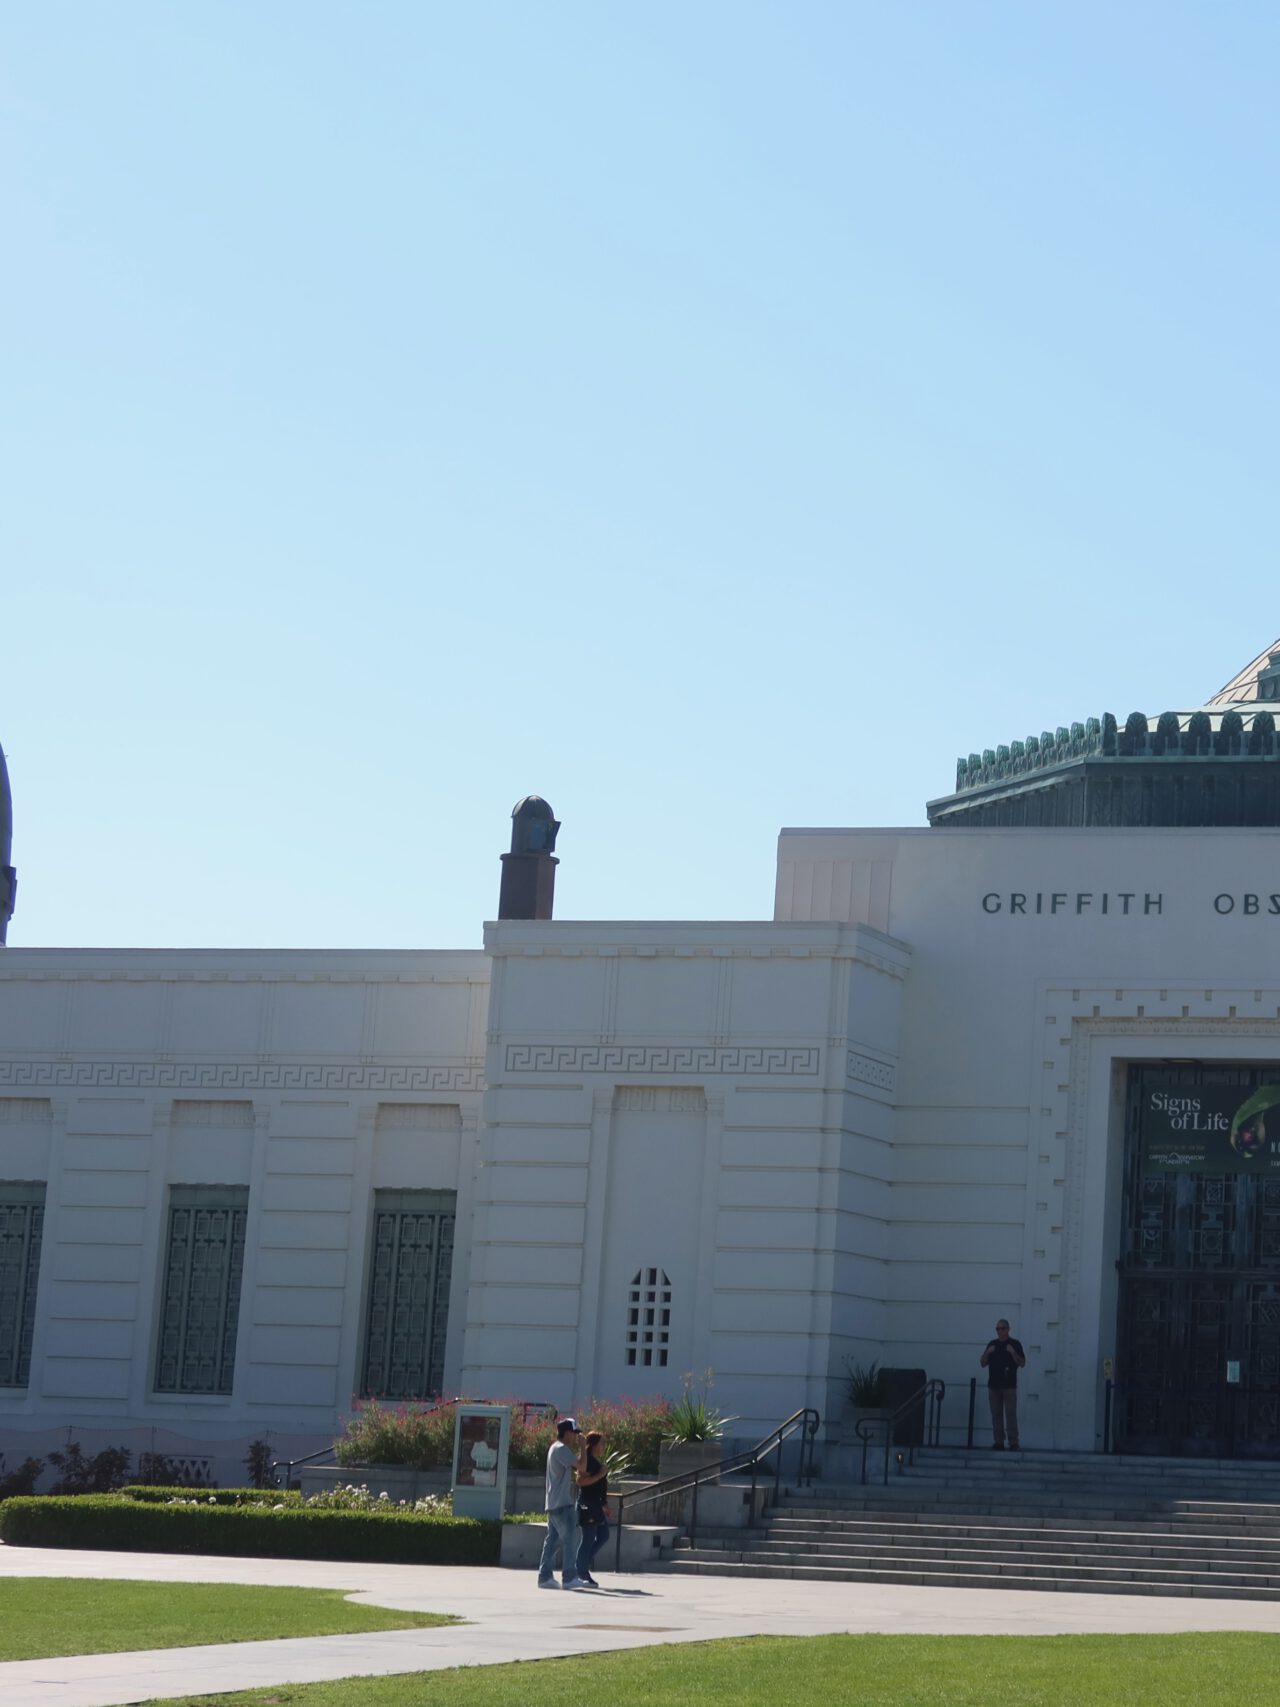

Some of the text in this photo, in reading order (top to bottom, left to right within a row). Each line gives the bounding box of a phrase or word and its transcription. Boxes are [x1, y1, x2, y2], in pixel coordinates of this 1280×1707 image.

[982, 893, 1164, 916] GRIFFITH
[1150, 1092, 1201, 1117] Signs
[1170, 1112, 1229, 1131] of Life
